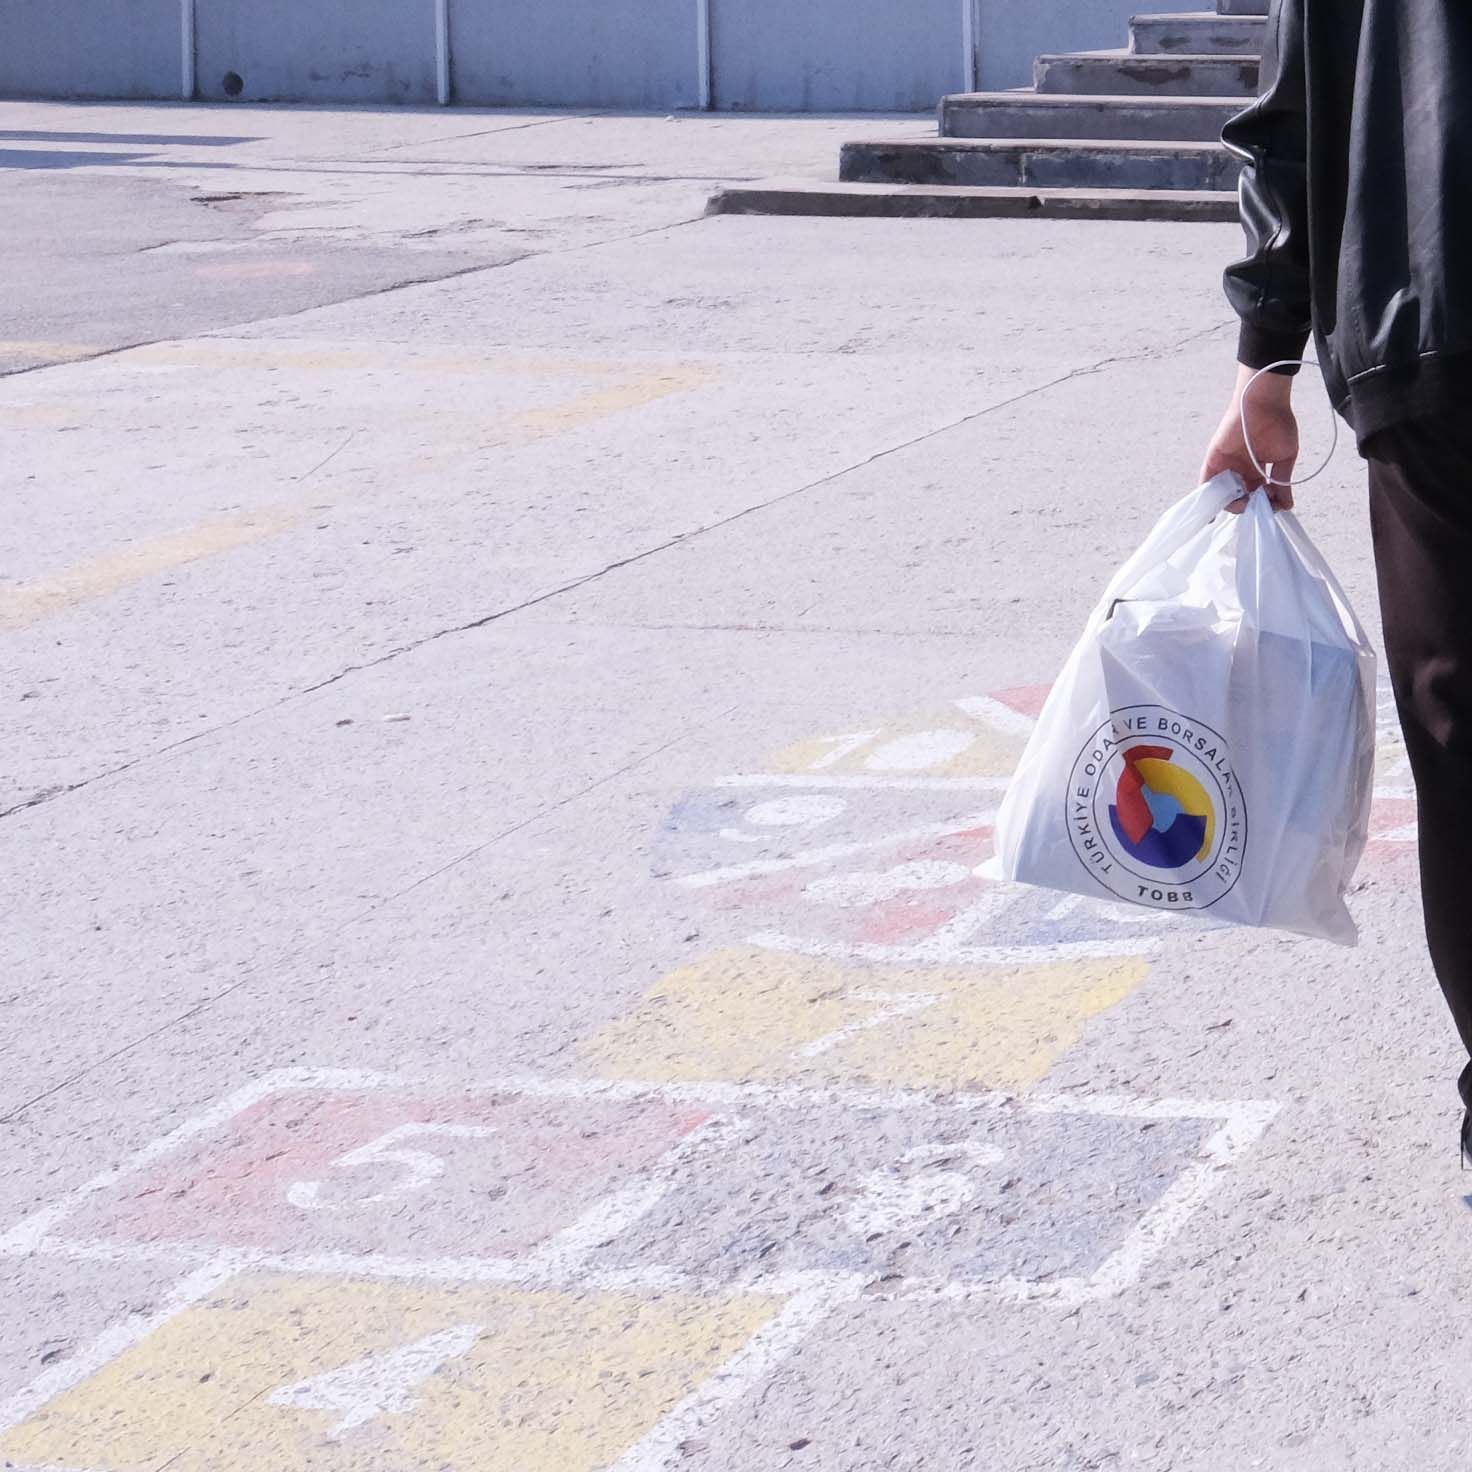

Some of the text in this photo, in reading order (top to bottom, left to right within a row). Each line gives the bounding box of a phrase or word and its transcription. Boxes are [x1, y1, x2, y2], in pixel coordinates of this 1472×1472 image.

[1073, 786, 1112, 875] TÜRKİYE
[1122, 717, 1147, 731] VE
[1136, 885, 1194, 903] TOBB
